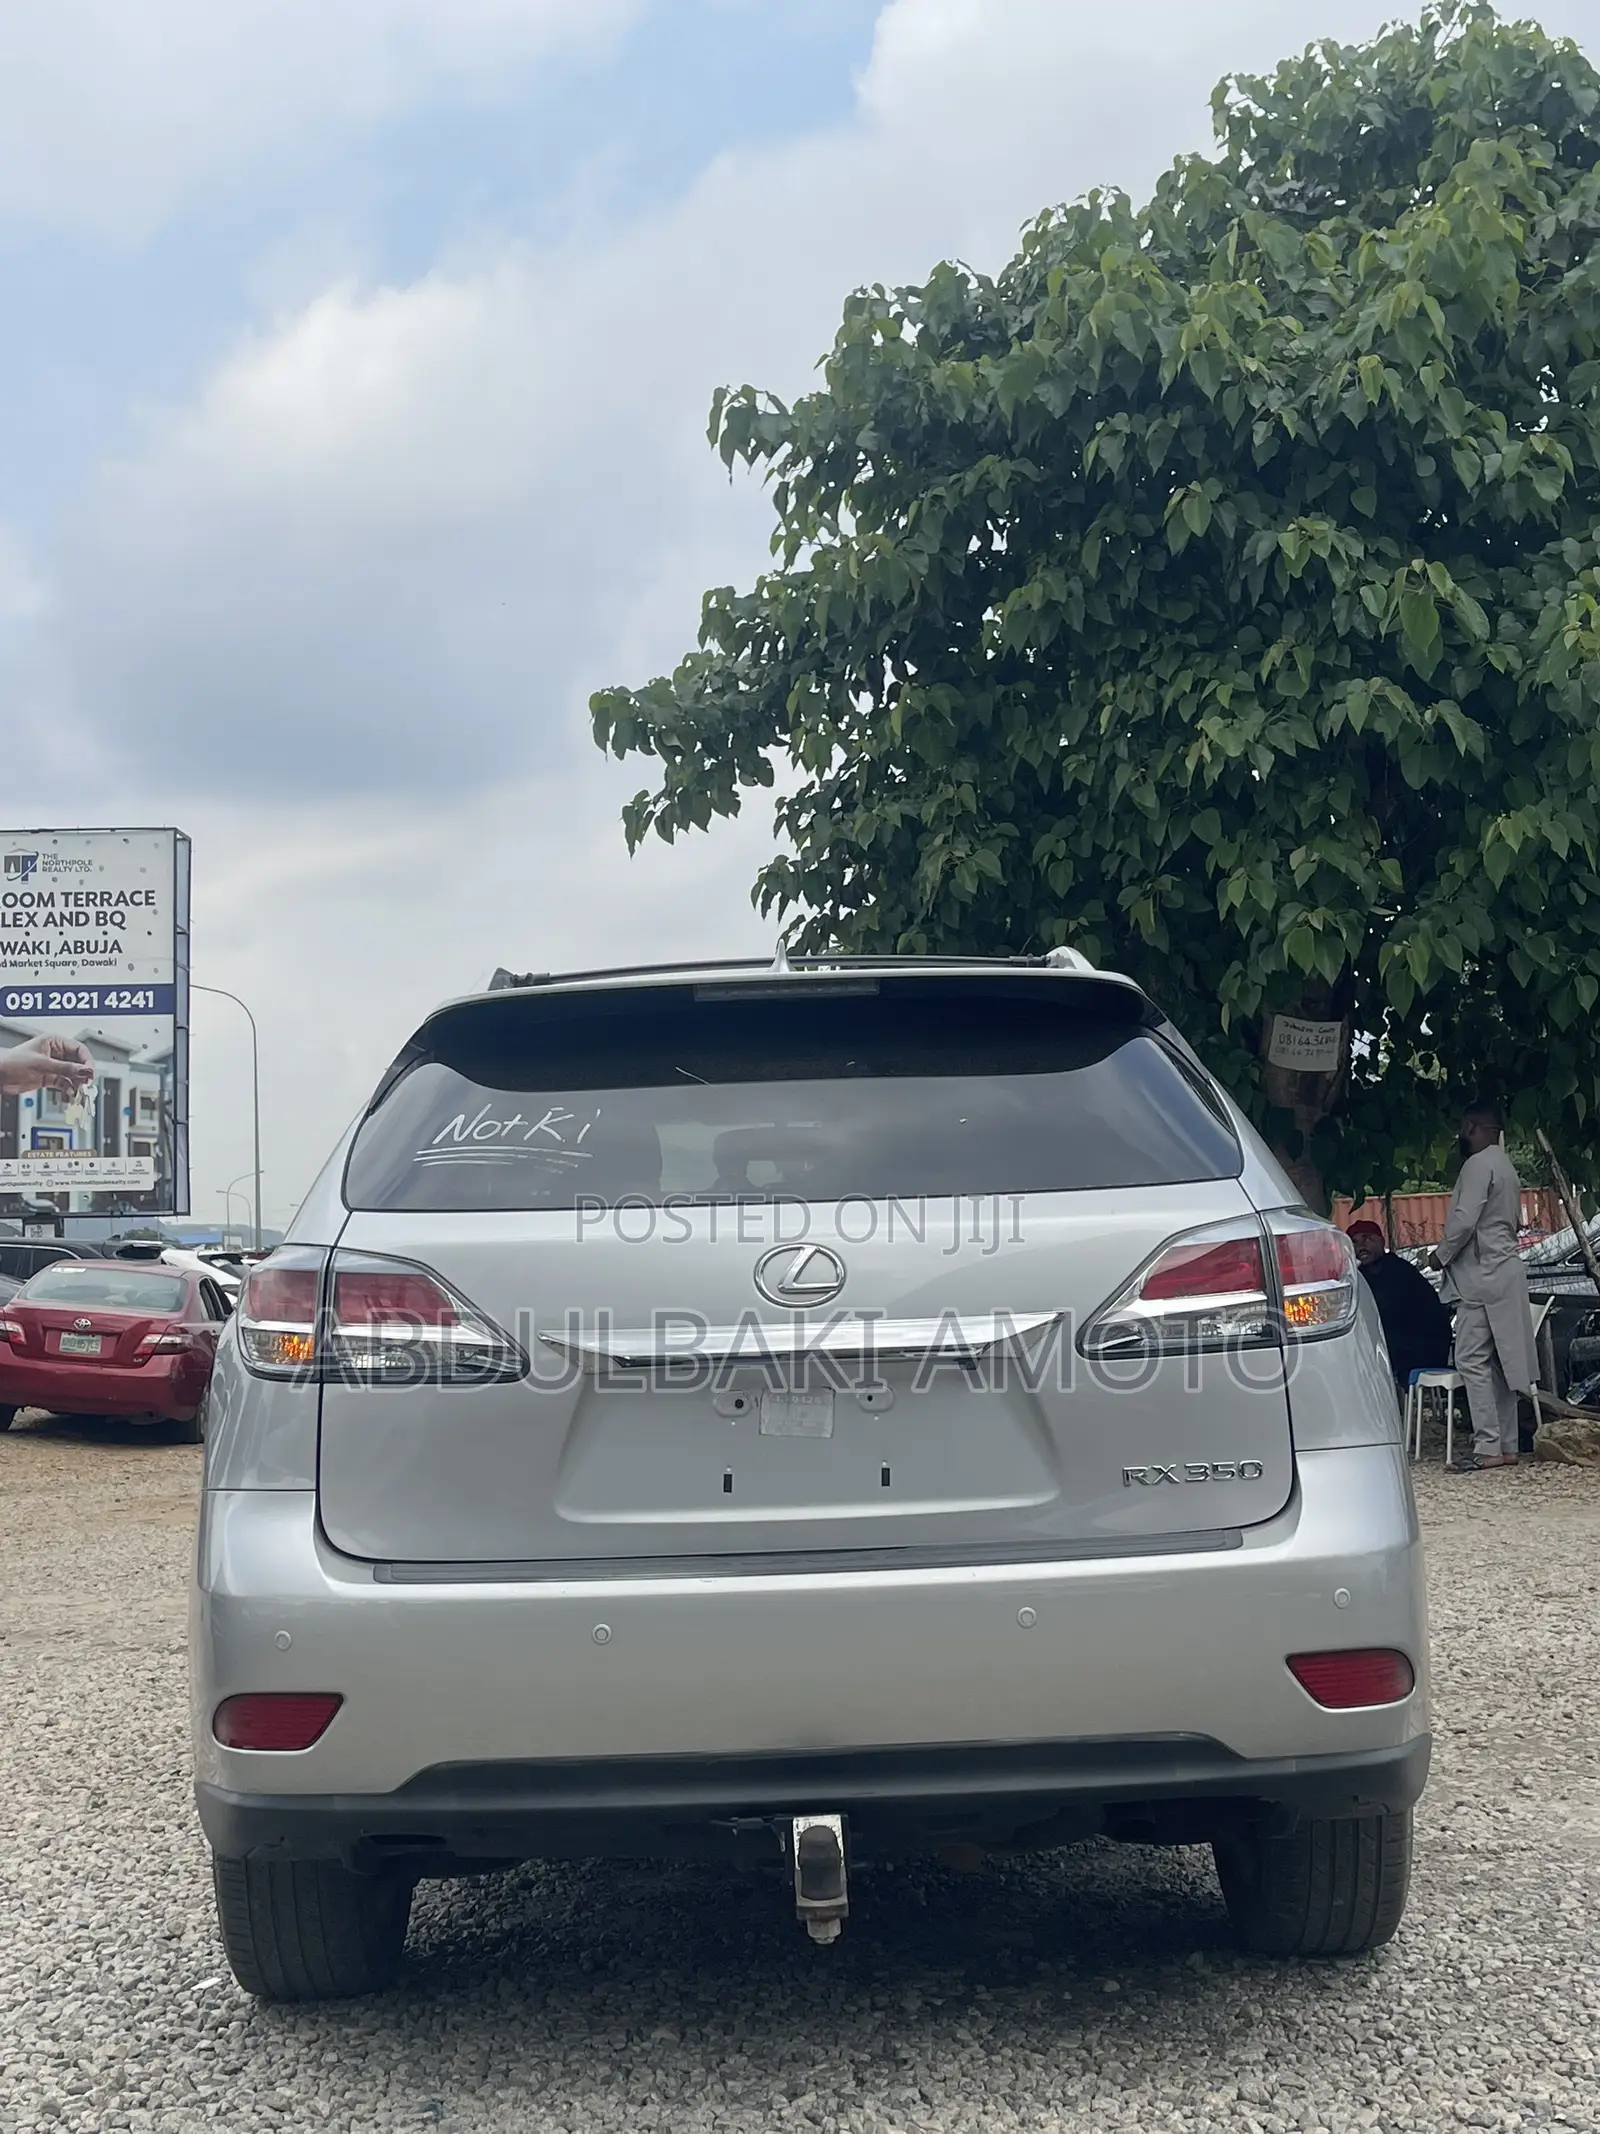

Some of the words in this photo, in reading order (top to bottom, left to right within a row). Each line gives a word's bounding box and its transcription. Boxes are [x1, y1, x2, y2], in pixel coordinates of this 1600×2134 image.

[0, 892, 56, 908] OOM
[61, 890, 156, 907] TERRACE
[1, 911, 39, 928] LEX
[43, 911, 90, 928] AND
[95, 911, 126, 930] BQ
[0, 940, 50, 956] WAKI
[9, 958, 43, 968] Market
[82, 958, 117, 967] Dawaki
[6, 992, 42, 1010] 091
[48, 991, 98, 1010] 2021
[104, 990, 154, 1009] 4241
[55, 1150, 92, 1158] FEATURES
[1122, 1464, 1180, 1487] RX
[1184, 1459, 1263, 1482] 350
